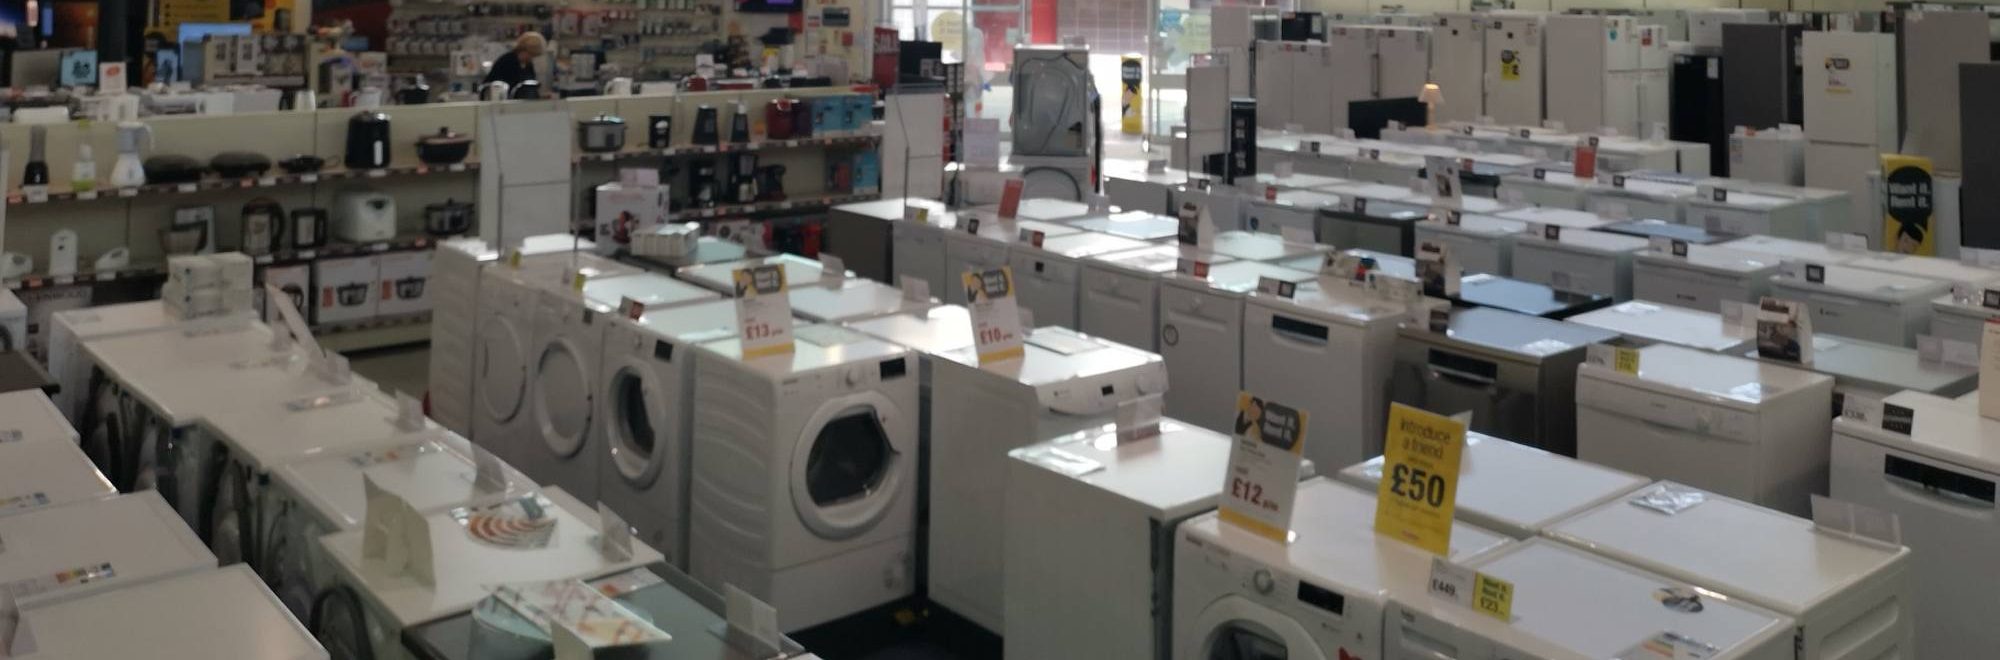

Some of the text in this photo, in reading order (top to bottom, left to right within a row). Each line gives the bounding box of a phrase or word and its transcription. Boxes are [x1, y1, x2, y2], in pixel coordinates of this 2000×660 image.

[1888, 181, 1917, 194] Want
[1890, 194, 1916, 208] Rent
[746, 323, 769, 339] £13
[981, 327, 1001, 344] £10
[1411, 437, 1444, 460] friend
[1231, 477, 1264, 505] £12
[1391, 462, 1445, 508] £50
